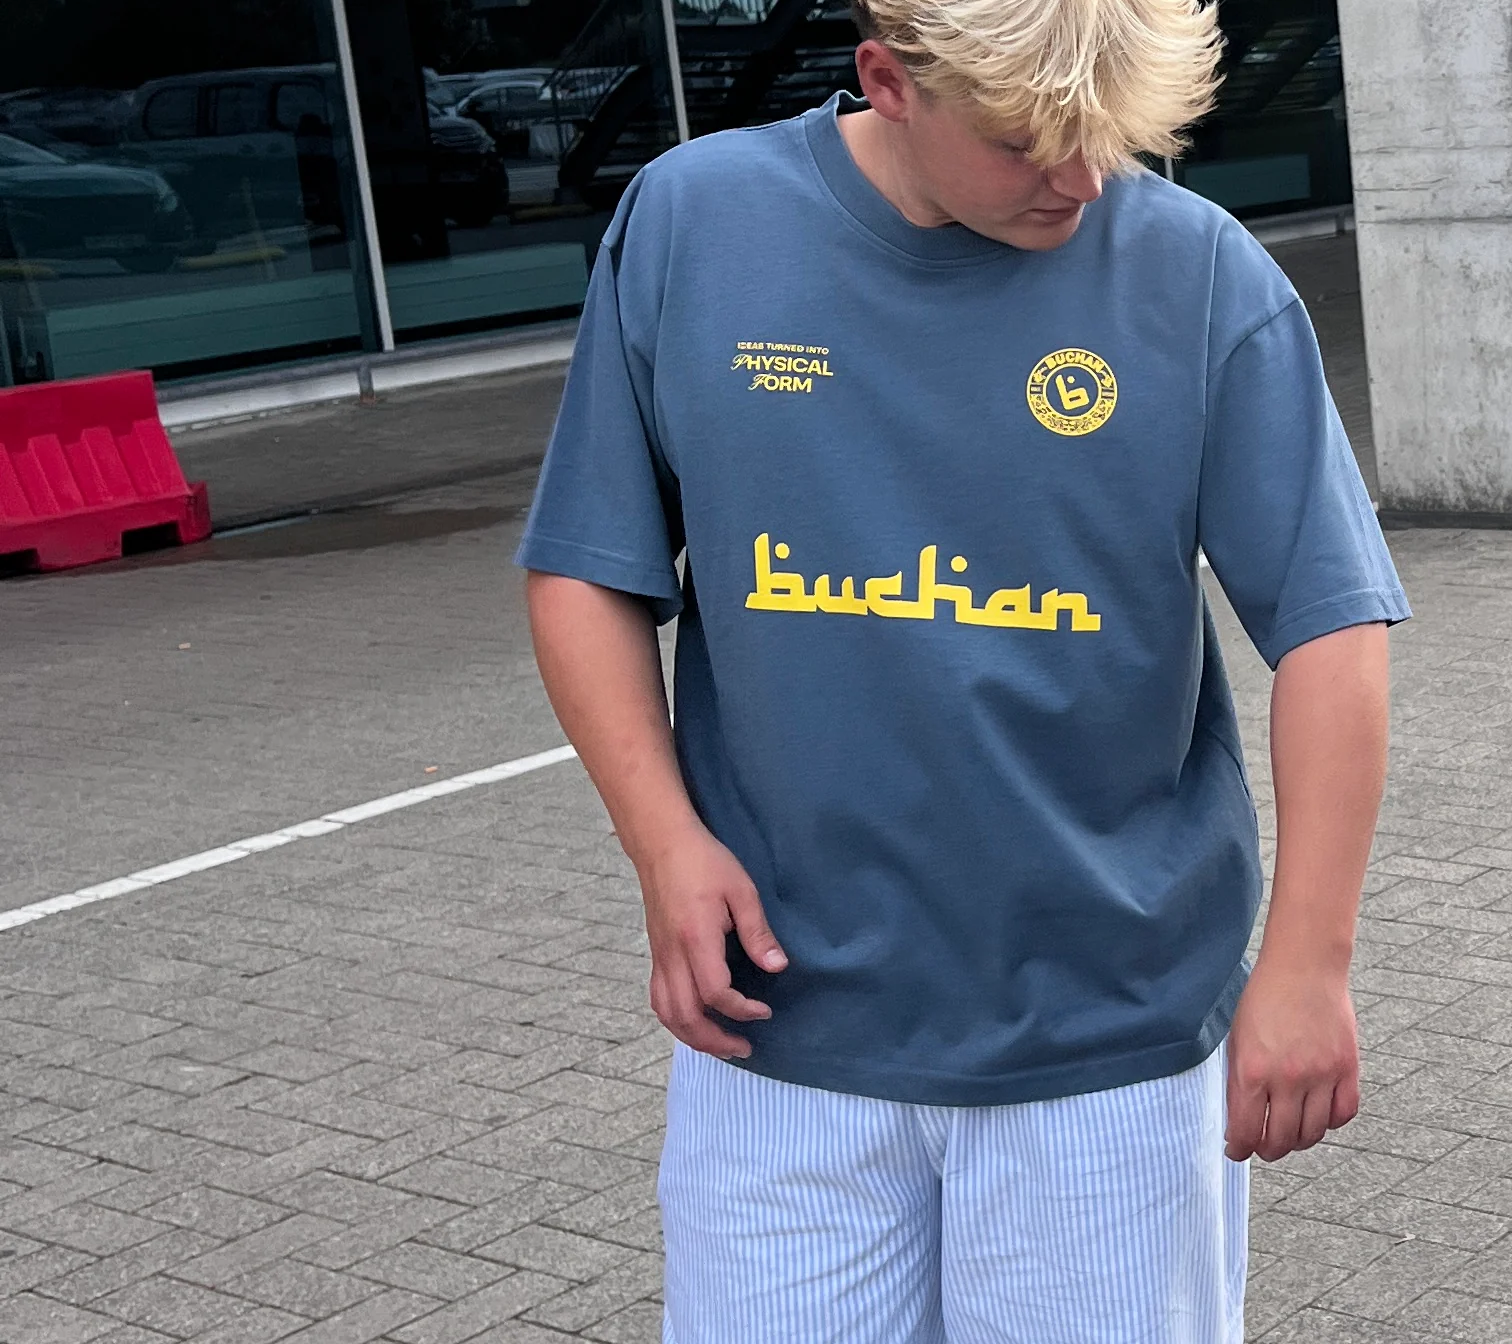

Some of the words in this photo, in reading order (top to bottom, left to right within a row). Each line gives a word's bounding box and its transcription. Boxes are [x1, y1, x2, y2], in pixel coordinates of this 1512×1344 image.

[737, 341, 764, 351] IDEAS
[766, 342, 804, 353] TURNED
[806, 345, 830, 355] INTO
[730, 353, 834, 377] PHYSICAL
[1044, 351, 1105, 374] BUCHAN
[747, 372, 813, 394] FORM
[745, 532, 1101, 632] buchan
